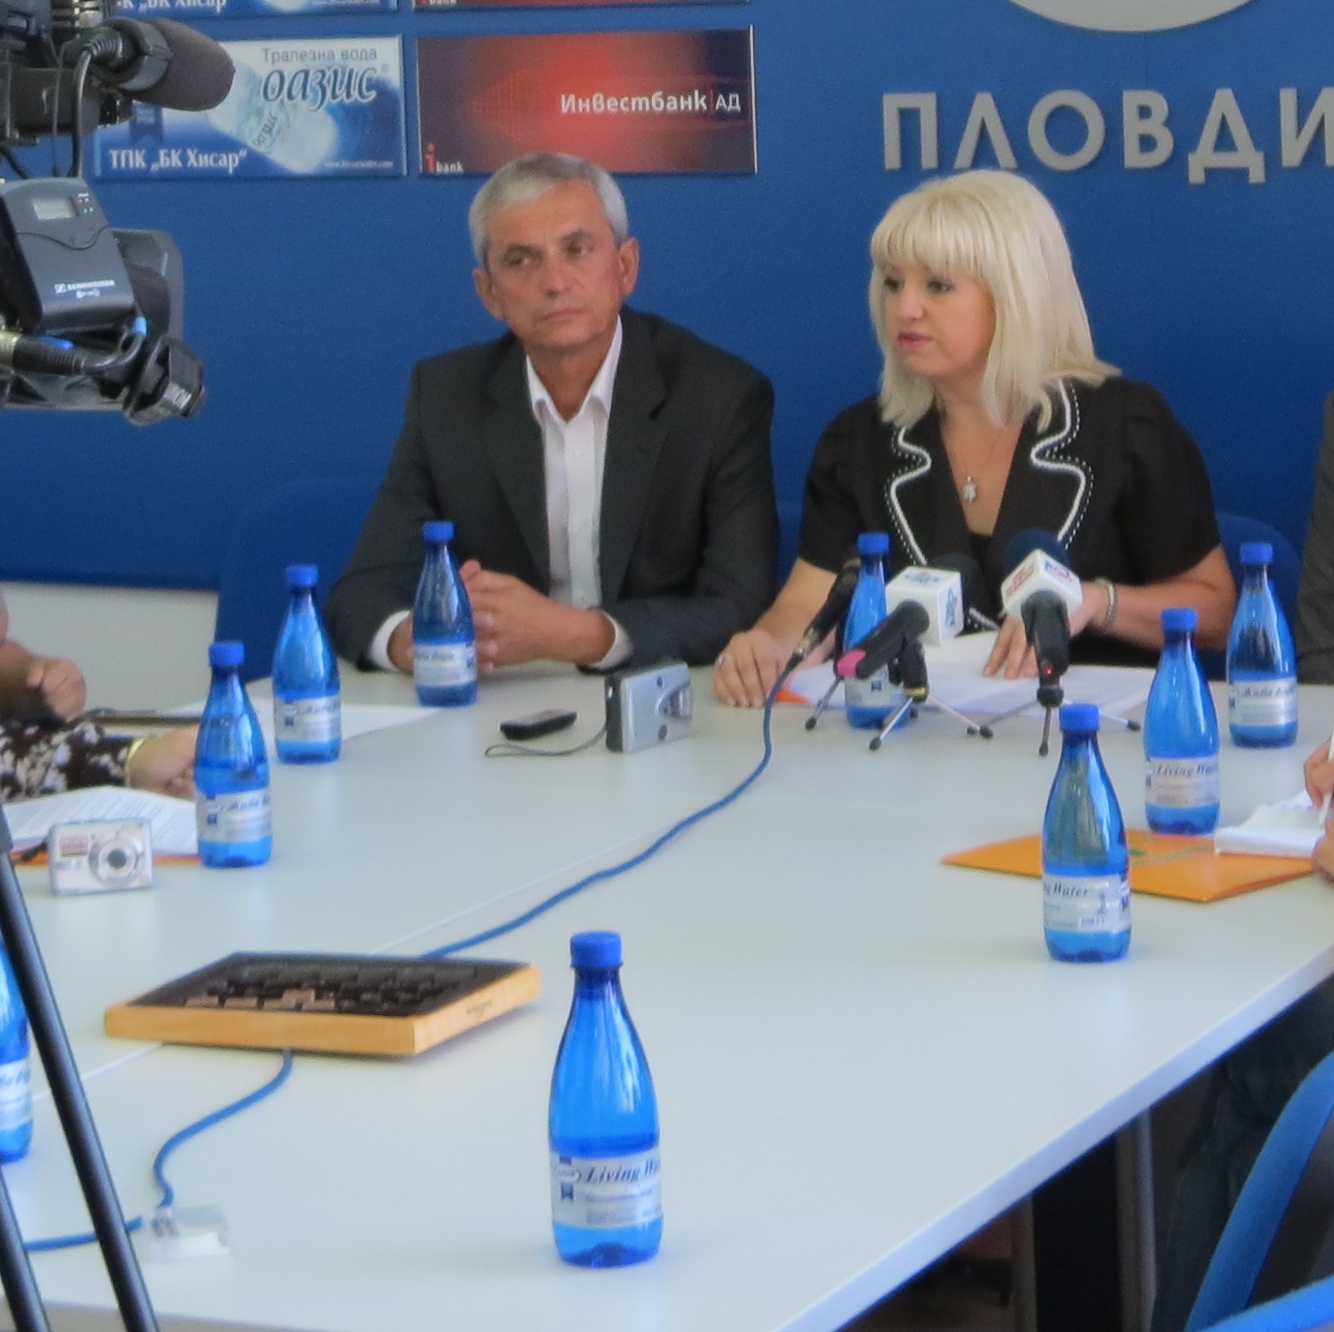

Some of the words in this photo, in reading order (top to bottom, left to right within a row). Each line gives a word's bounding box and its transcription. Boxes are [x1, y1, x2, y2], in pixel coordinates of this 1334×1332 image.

[262, 48, 334, 64] Трапезна
[341, 47, 378, 61] вода
[262, 65, 378, 111] оазис
[561, 88, 707, 114] Инвестбанк
[715, 93, 742, 112] АД
[108, 150, 145, 167] ТПК
